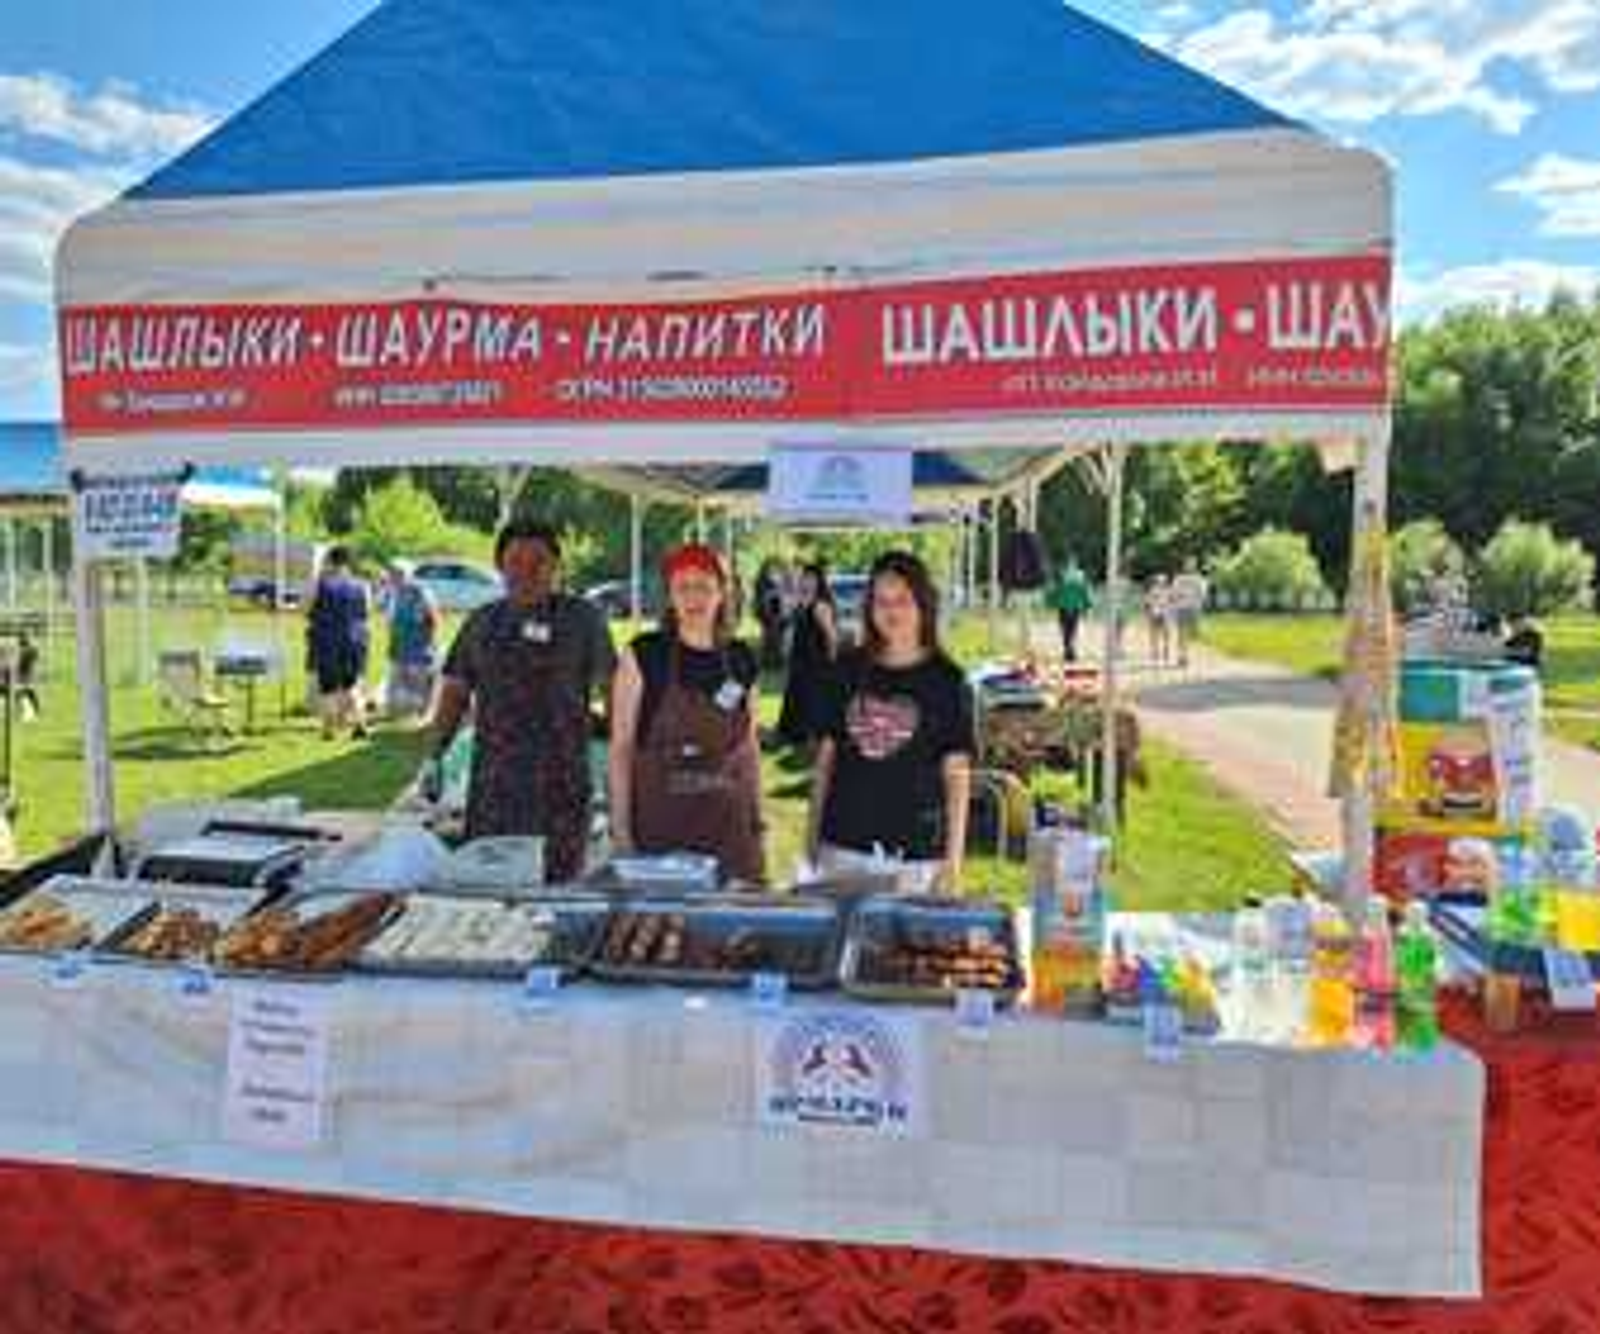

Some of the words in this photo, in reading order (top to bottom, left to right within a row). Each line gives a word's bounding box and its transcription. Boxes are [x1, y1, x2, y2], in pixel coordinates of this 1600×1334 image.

[66, 314, 301, 374] ШАШЛЫКИ
[335, 307, 543, 368] ШАУРМА
[585, 304, 824, 360] НАПИТКИ
[883, 288, 1217, 364] ШАШЛЫКИ
